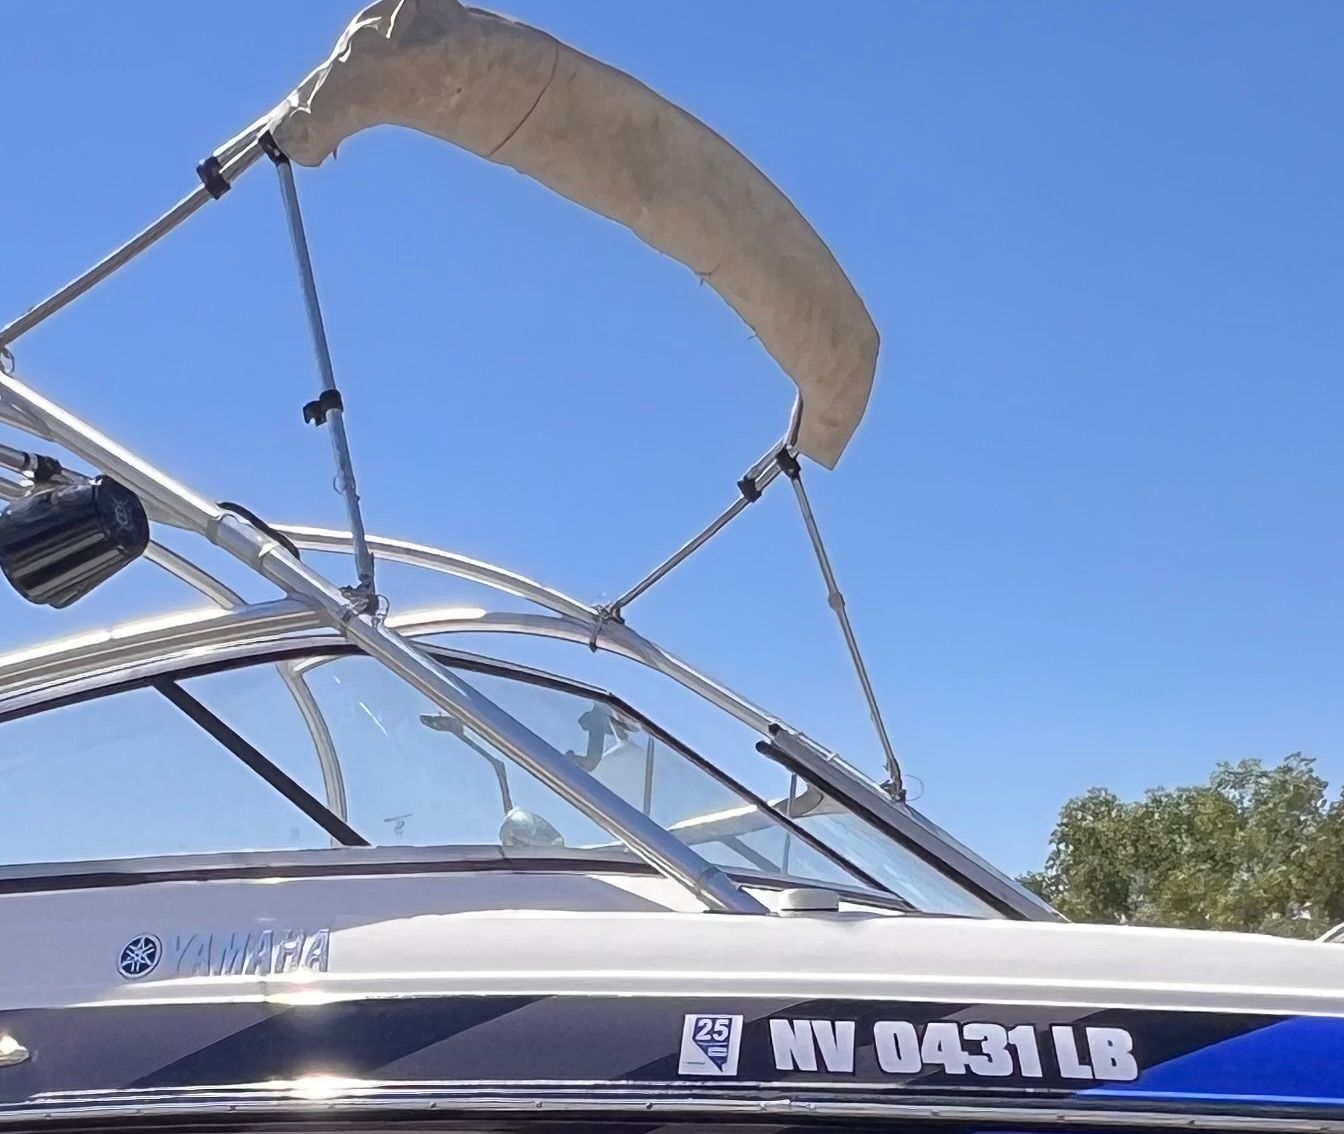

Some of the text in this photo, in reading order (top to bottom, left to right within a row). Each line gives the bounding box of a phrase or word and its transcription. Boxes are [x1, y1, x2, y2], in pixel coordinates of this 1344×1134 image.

[169, 928, 331, 977] YAMAHA
[695, 1018, 730, 1042] 25
[768, 1018, 1139, 1081] NV 0431 LB
